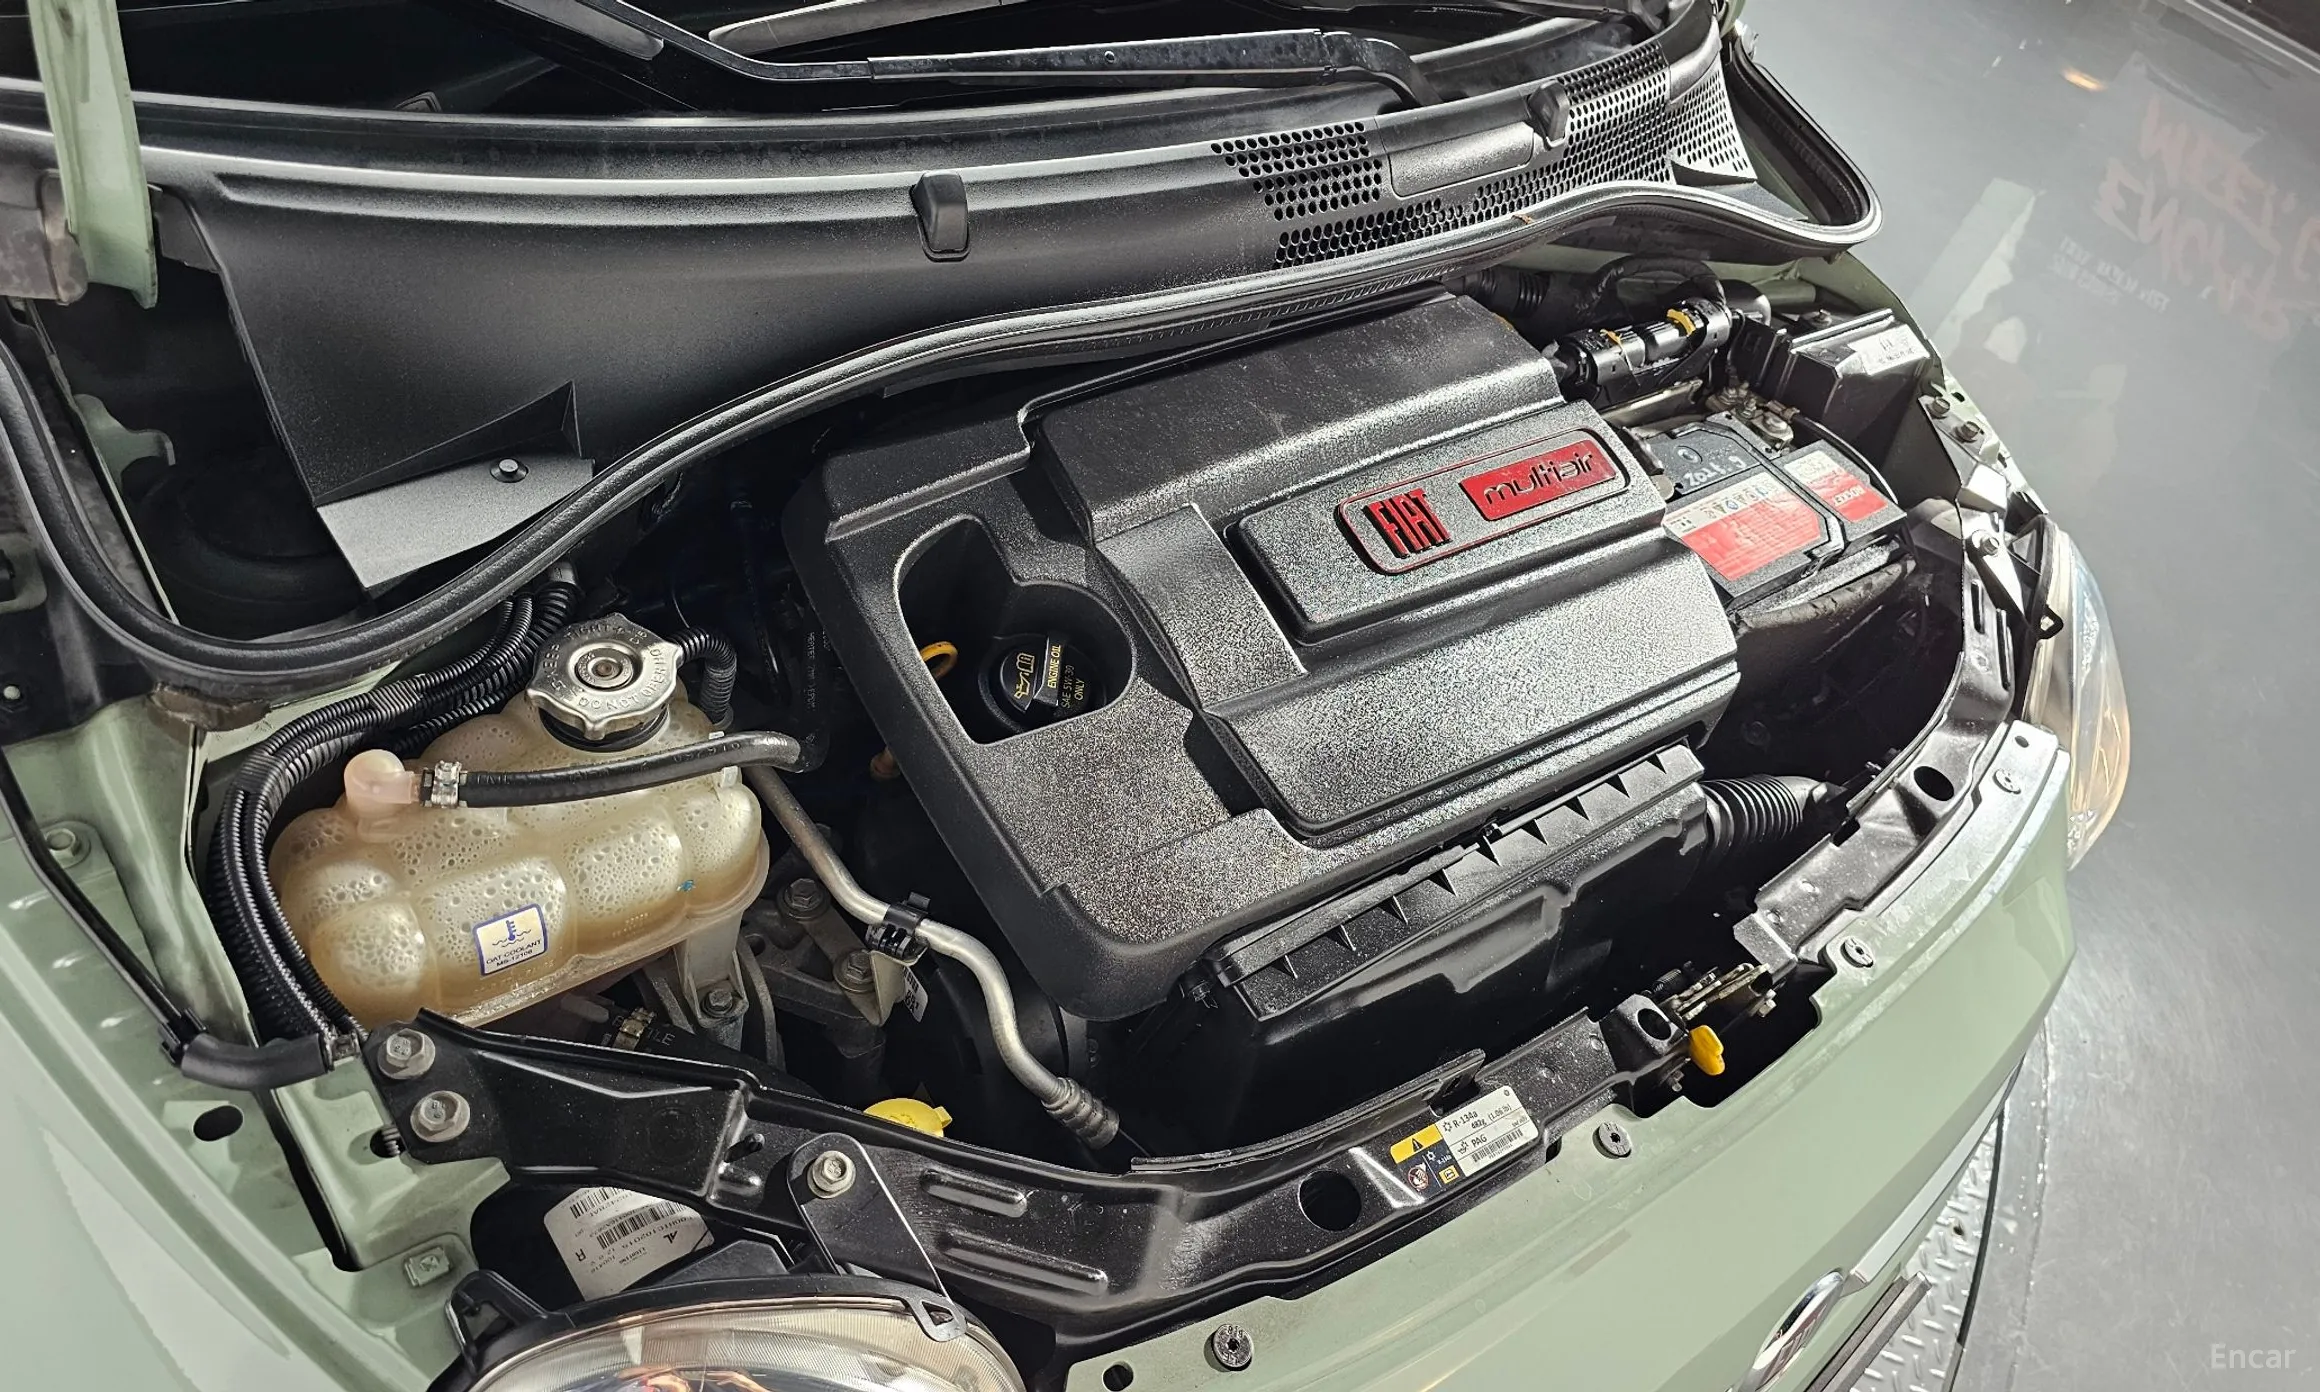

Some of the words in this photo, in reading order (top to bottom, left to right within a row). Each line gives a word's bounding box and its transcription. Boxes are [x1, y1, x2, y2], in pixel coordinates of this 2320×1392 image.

[1482, 451, 1594, 506] multiair
[1364, 487, 1451, 558] FIAT
[1051, 644, 1062, 658] OIL
[1047, 658, 1061, 689] ENGINE
[1074, 678, 1085, 701] ONLY
[1061, 691, 1072, 709] SAE
[486, 954, 502, 965] OAT
[504, 939, 541, 957] COOLANT
[1453, 1111, 1478, 1128] R-134a
[1471, 1134, 1487, 1148] PAG
[574, 1249, 587, 1262] R
